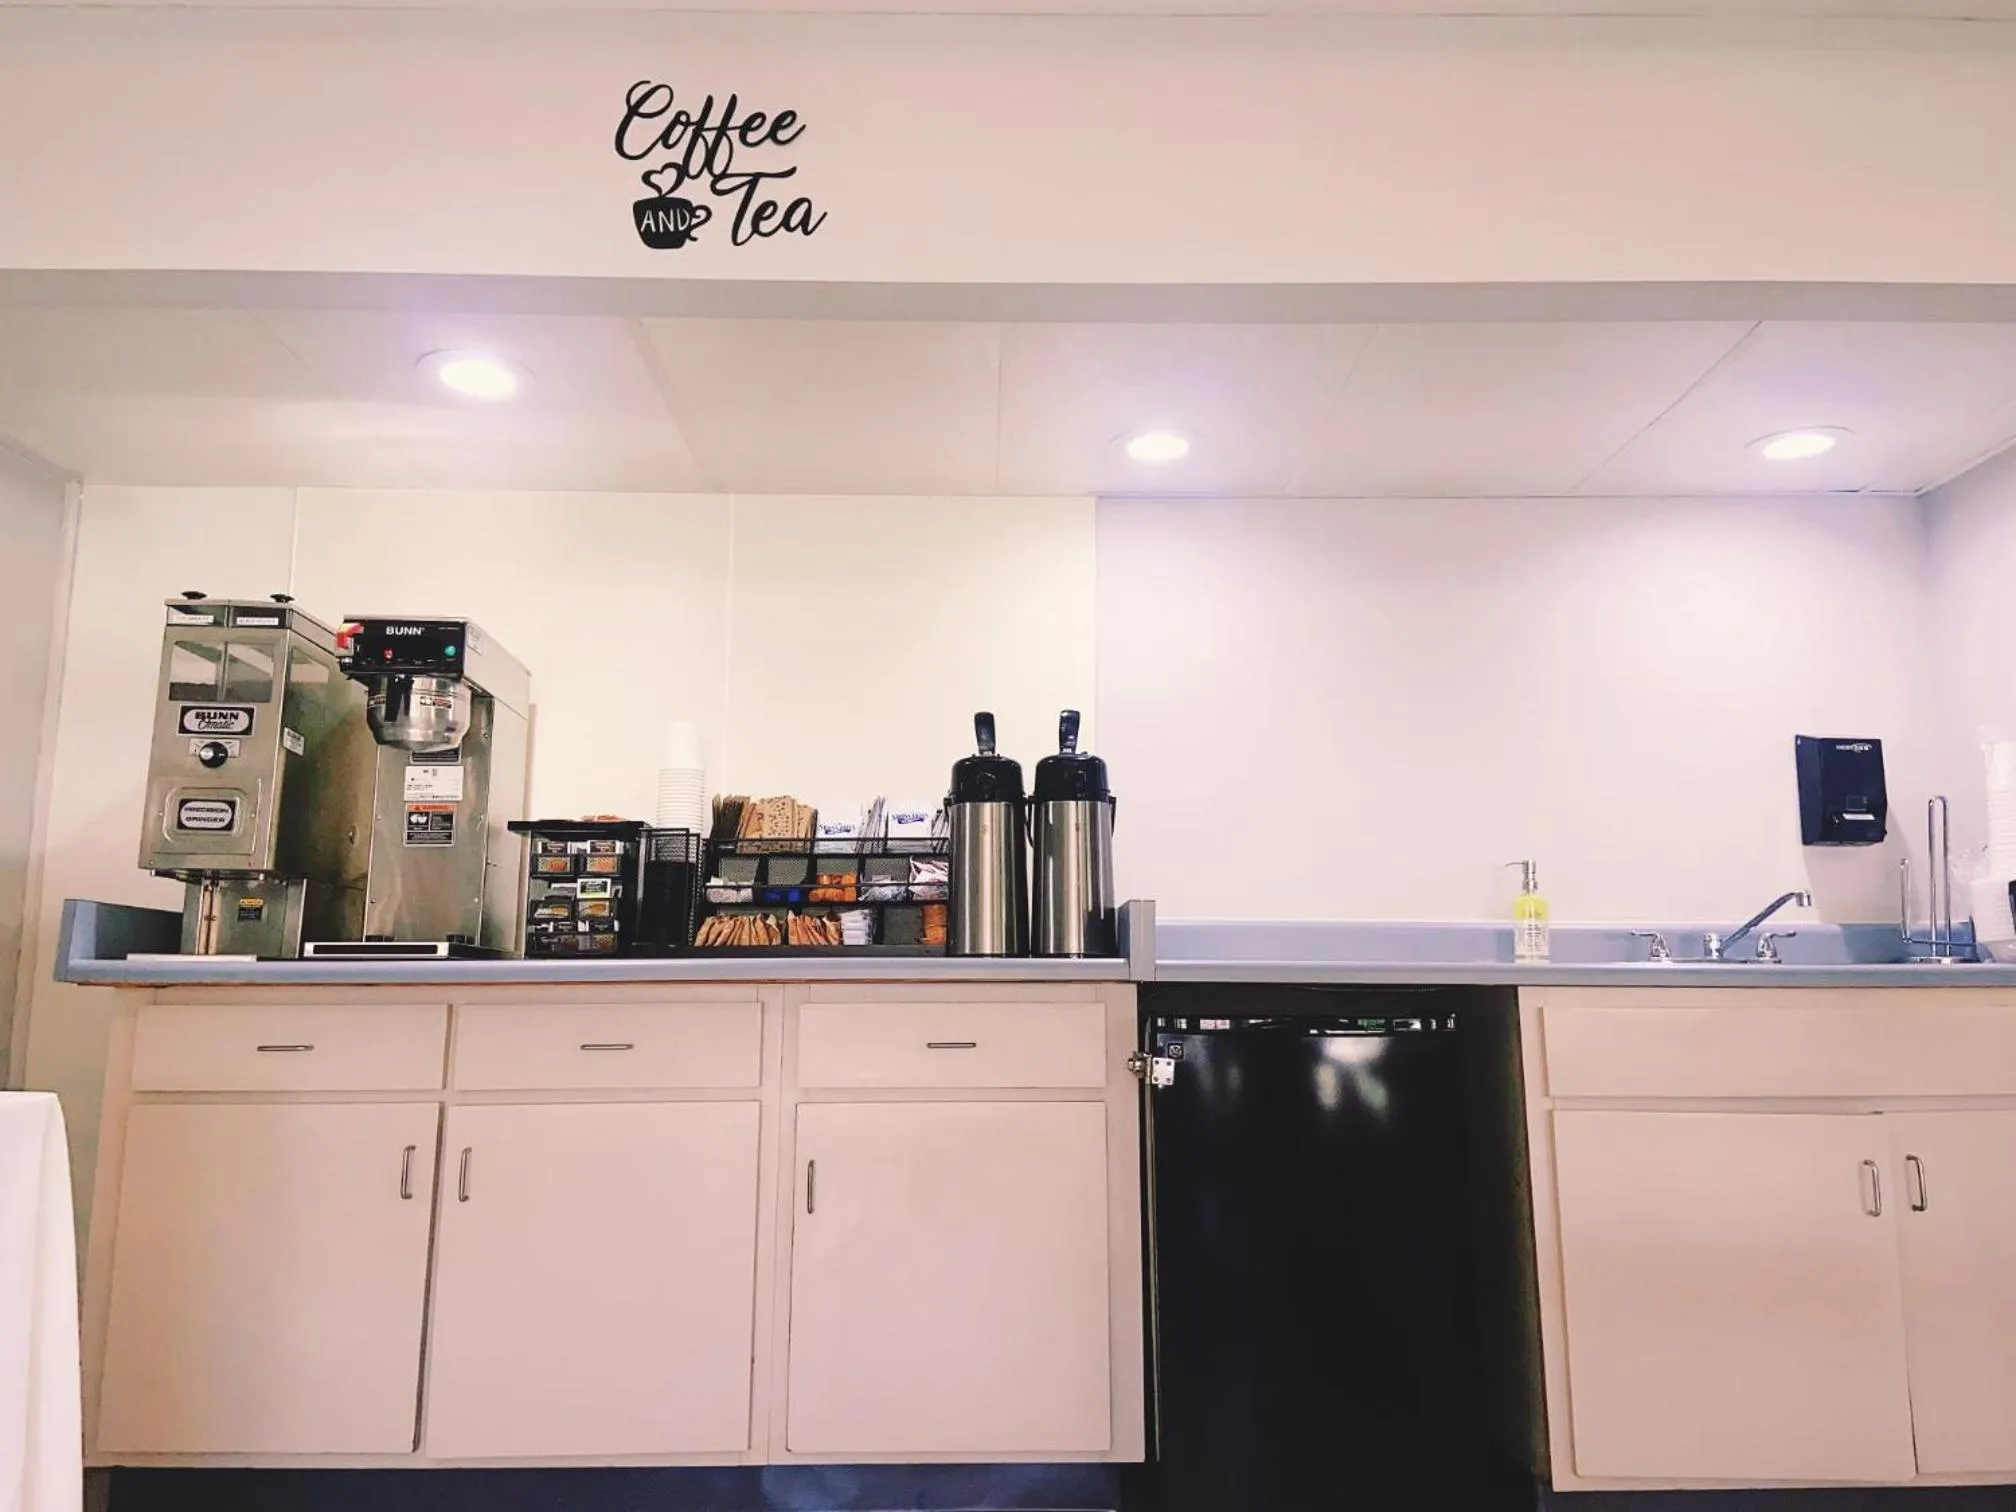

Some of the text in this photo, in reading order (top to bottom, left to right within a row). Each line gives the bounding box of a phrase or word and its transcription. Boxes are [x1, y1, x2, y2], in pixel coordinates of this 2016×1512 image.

[614, 80, 807, 180] Coffee
[640, 165, 828, 247] AND Tea
[385, 625, 423, 636] BUNN
[194, 711, 240, 721] BUNN
